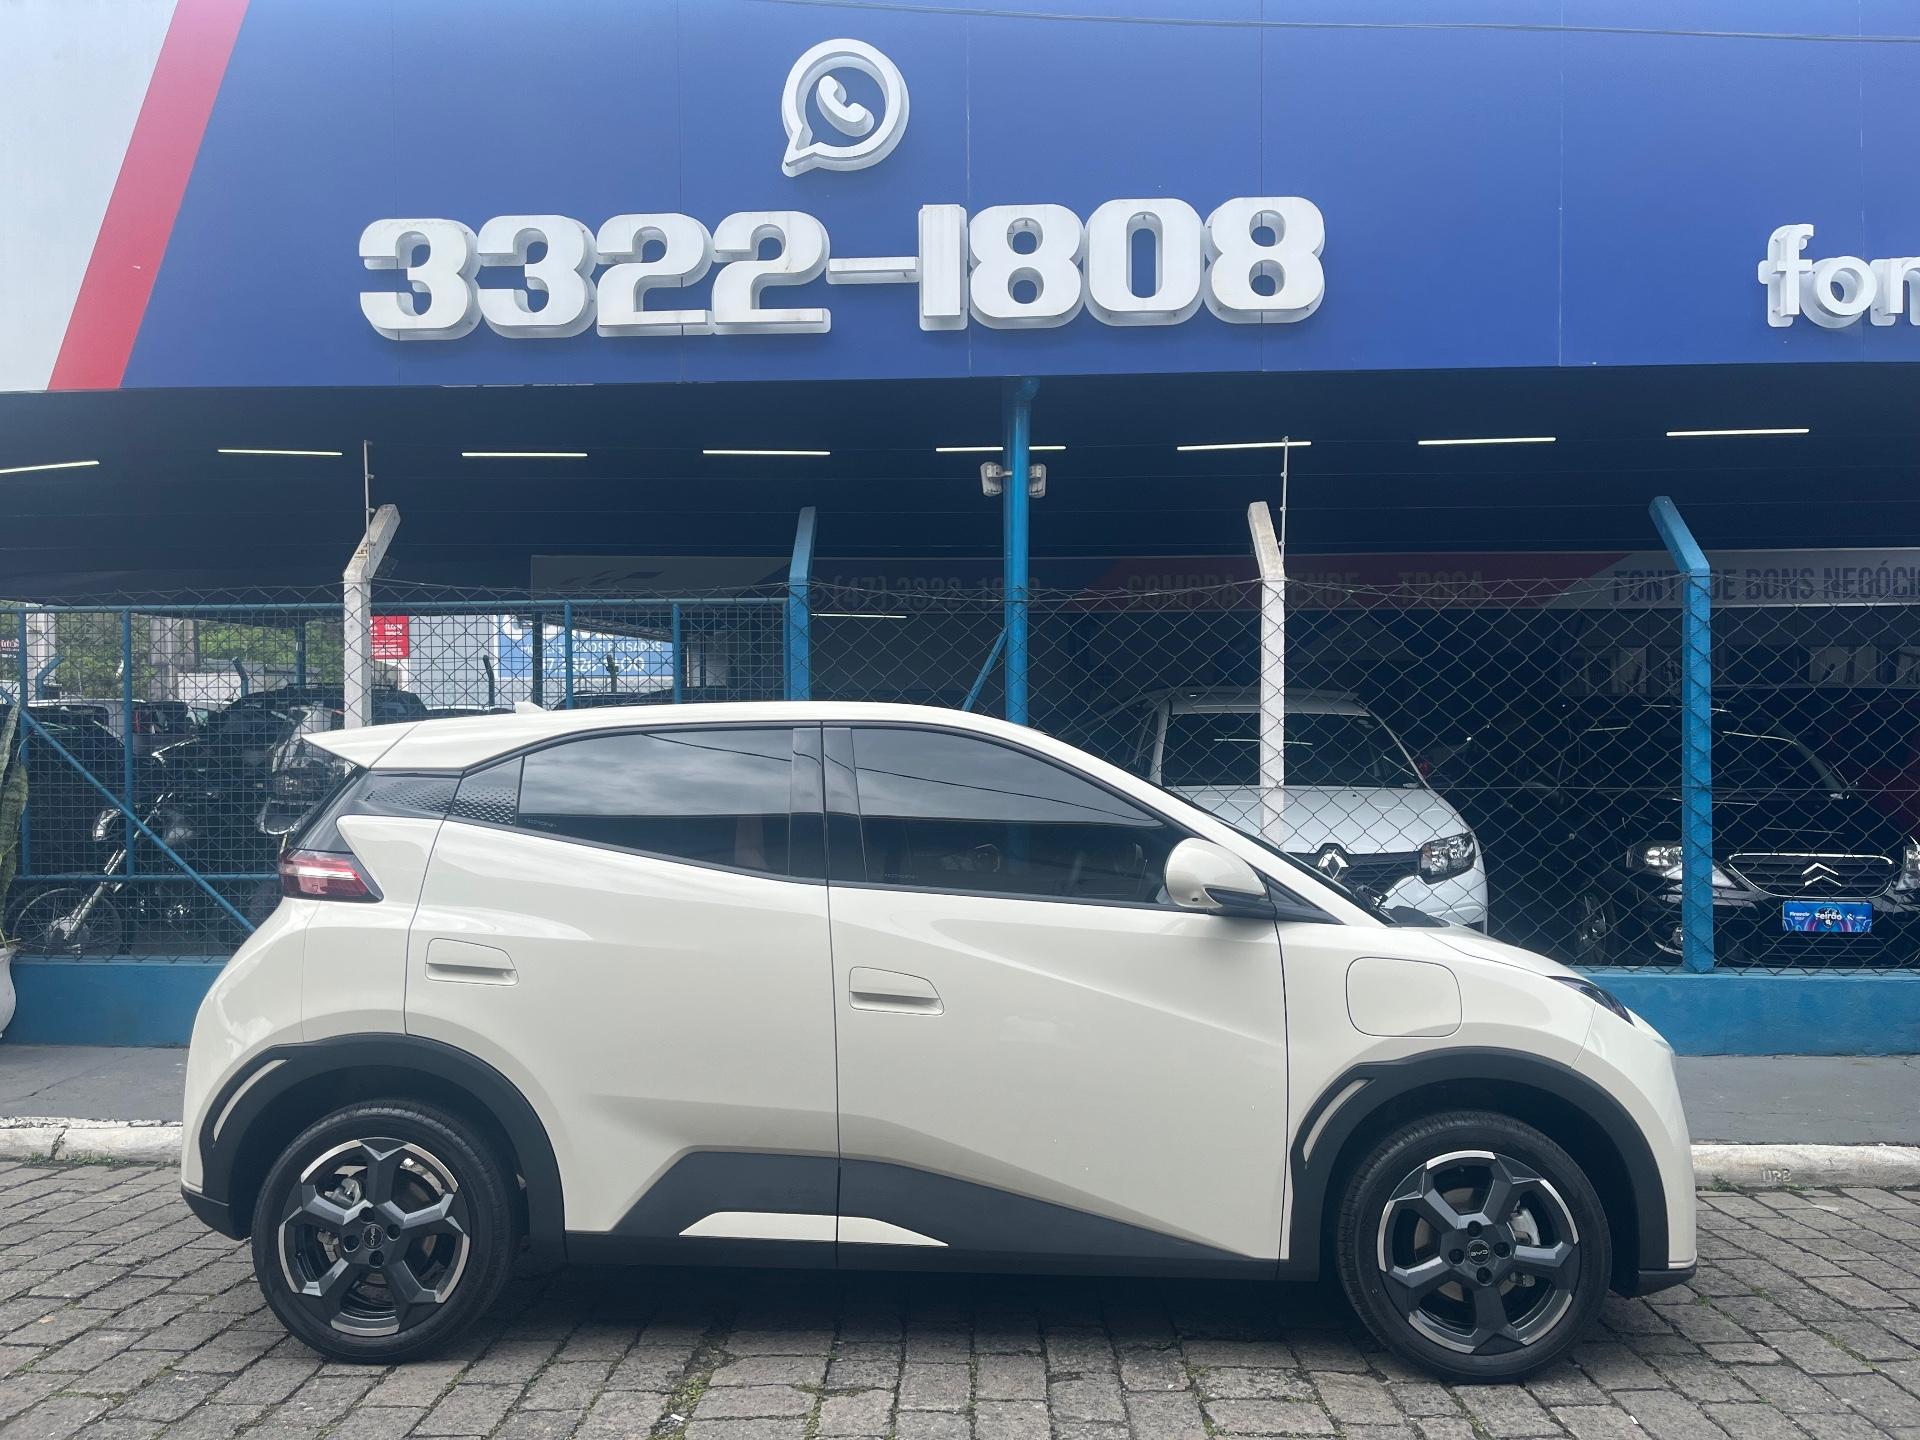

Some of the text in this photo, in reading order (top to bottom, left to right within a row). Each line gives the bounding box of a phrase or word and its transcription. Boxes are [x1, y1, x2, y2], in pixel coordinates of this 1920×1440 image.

[359, 197, 1326, 341] 3322-1808
[1286, 571, 1361, 608] ENDE
[1612, 569, 1684, 602] FONT
[1745, 567, 1815, 601] BONS
[1822, 559, 1920, 600] NEGÓCI
[1470, 1249, 1489, 1257] BYD
